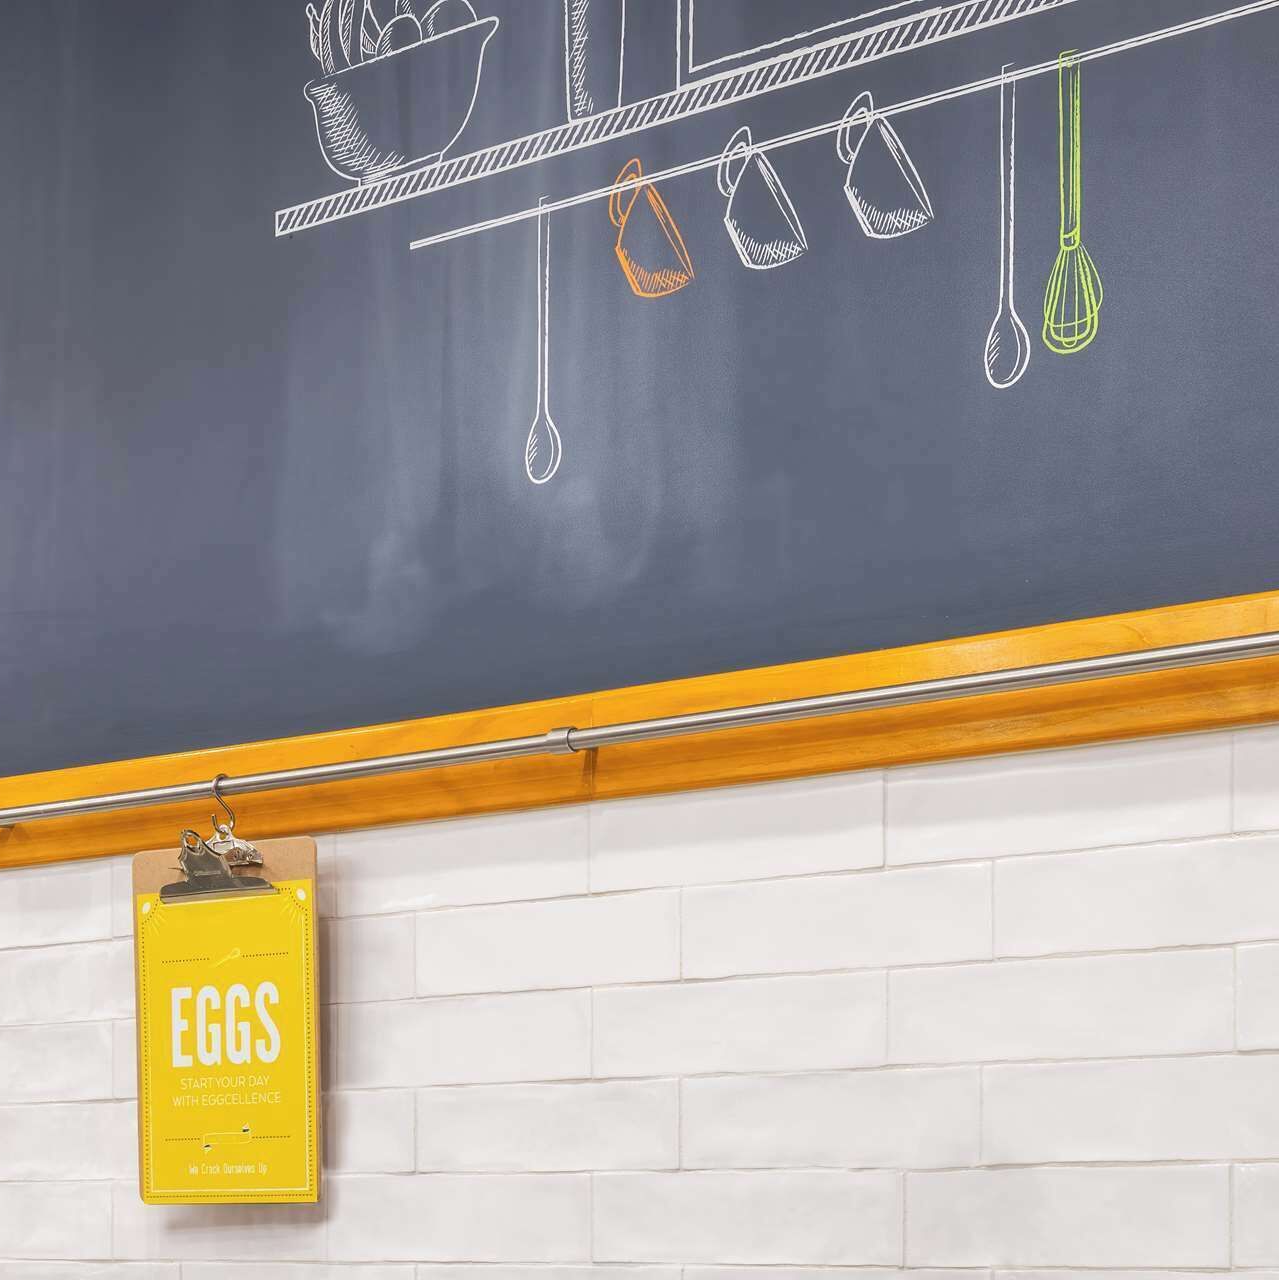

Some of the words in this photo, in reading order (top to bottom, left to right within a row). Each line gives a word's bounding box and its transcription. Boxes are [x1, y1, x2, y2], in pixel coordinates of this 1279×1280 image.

[171, 981, 281, 1068] EGGS
[180, 1077, 213, 1090] START
[214, 1075, 246, 1088] YOUR
[249, 1075, 270, 1087] DAY
[172, 1095, 199, 1107] WITH
[202, 1091, 281, 1106] EGGCELLENCE
